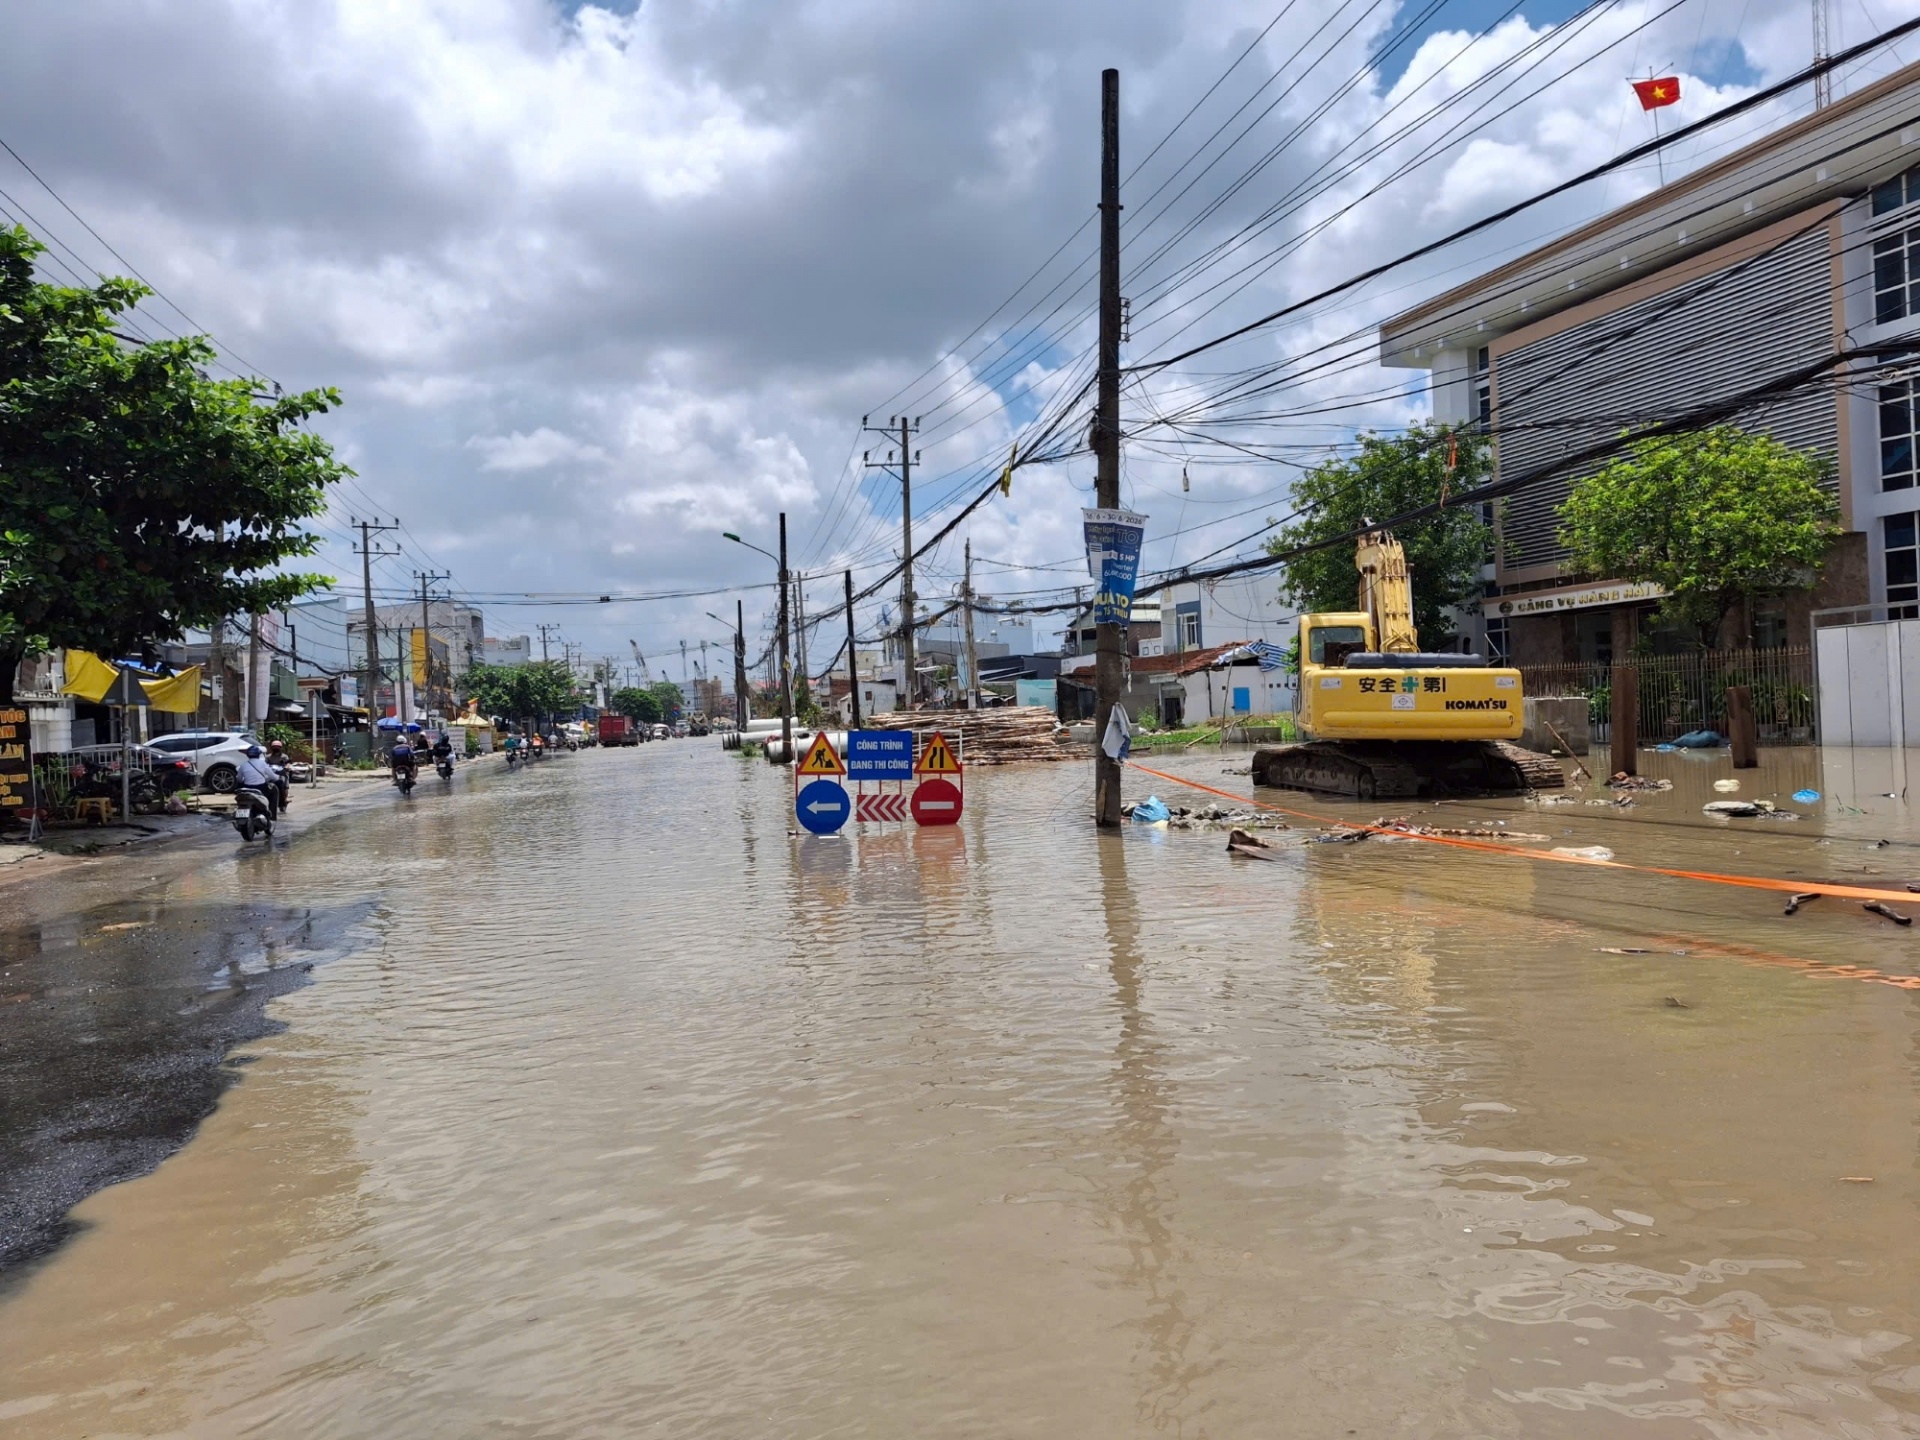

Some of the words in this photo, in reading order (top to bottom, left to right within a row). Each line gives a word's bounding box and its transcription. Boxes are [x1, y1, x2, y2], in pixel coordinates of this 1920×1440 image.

[1359, 677, 1397, 693] 安全
[1445, 698, 1507, 710] KOMATSU
[856, 739, 878, 750] CÔNG
[880, 739, 903, 750] TRÌNH
[851, 760, 873, 770] ĐANG
[874, 760, 887, 770] THI
[887, 758, 909, 770] CÔNG
